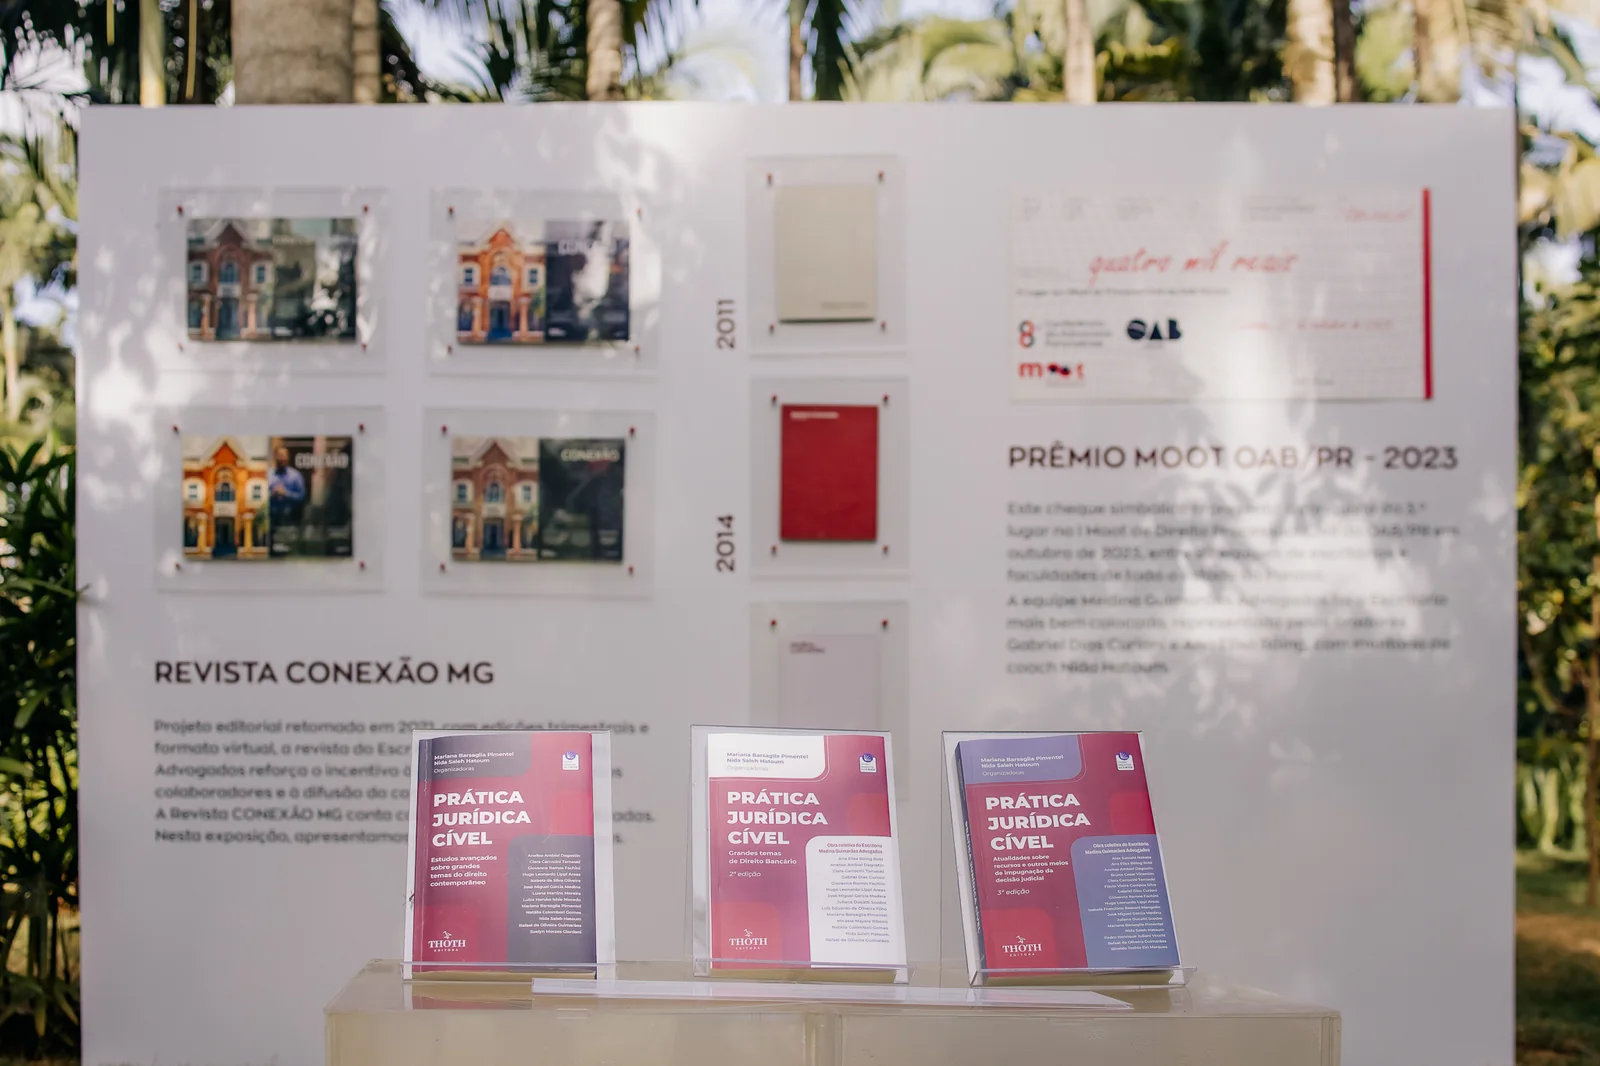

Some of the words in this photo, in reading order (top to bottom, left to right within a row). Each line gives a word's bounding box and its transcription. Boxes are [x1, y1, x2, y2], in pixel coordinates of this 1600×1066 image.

[1089, 247, 1172, 288] quatro
[1182, 239, 1229, 273] mil
[716, 298, 736, 350] 2011
[1126, 318, 1182, 340] OAB
[1008, 439, 1126, 470] PRÊMIO
[1134, 445, 1224, 470] MOOT
[1235, 445, 1354, 470] OAB/PR
[1384, 445, 1459, 470] 2023
[716, 514, 736, 574] 2014
[155, 661, 278, 684] REVISTA
[286, 656, 439, 684] CONEXÃO
[447, 661, 495, 684] MG
[154, 720, 212, 736] Projeto
[216, 719, 282, 733] editorial
[286, 720, 365, 733] retomado
[370, 724, 394, 733] em
[641, 724, 648, 733] e
[154, 742, 220, 755] formato
[223, 742, 278, 757] virtual,
[281, 745, 290, 755] a
[295, 743, 349, 755] revista
[353, 742, 374, 755] do
[155, 764, 245, 778] Advogados
[249, 764, 308, 779] reforça
[311, 767, 321, 777] o
[325, 764, 399, 777] incentivo
[433, 766, 475, 774] Organizadoras
[982, 769, 1024, 777] Organizadoras
[154, 786, 272, 799] colaboradores
[276, 788, 285, 799] e
[303, 785, 362, 799] difusão
[433, 789, 524, 807] PRÁTICA
[728, 788, 820, 805] PRÁTICA
[985, 793, 1080, 810] PRÁTICA
[155, 808, 166, 820] A
[170, 807, 228, 820] Revista
[232, 805, 313, 821] CONEXÃO
[317, 808, 343, 821] MG
[346, 808, 391, 821] conta
[432, 809, 531, 827] JURÍDICA
[727, 808, 828, 825] JURÍDICA
[987, 812, 1091, 830] JURÍDICA
[155, 830, 201, 842] Nesta
[205, 830, 290, 845] exposição,
[432, 829, 493, 847] CÍVEL
[728, 828, 790, 844] CÍVEL
[990, 834, 1054, 851] CÍVEL
[431, 855, 459, 863] Estudos
[460, 854, 497, 863] avançados
[430, 863, 449, 871] sobre
[451, 863, 480, 872] grandes
[1004, 868, 1043, 877] impugnação
[430, 879, 486, 888] contemporâneo
[1006, 888, 1030, 896] edição
[428, 939, 466, 949] THOTH
[729, 938, 767, 946] THOTH
[1002, 944, 1042, 953] THOTH
